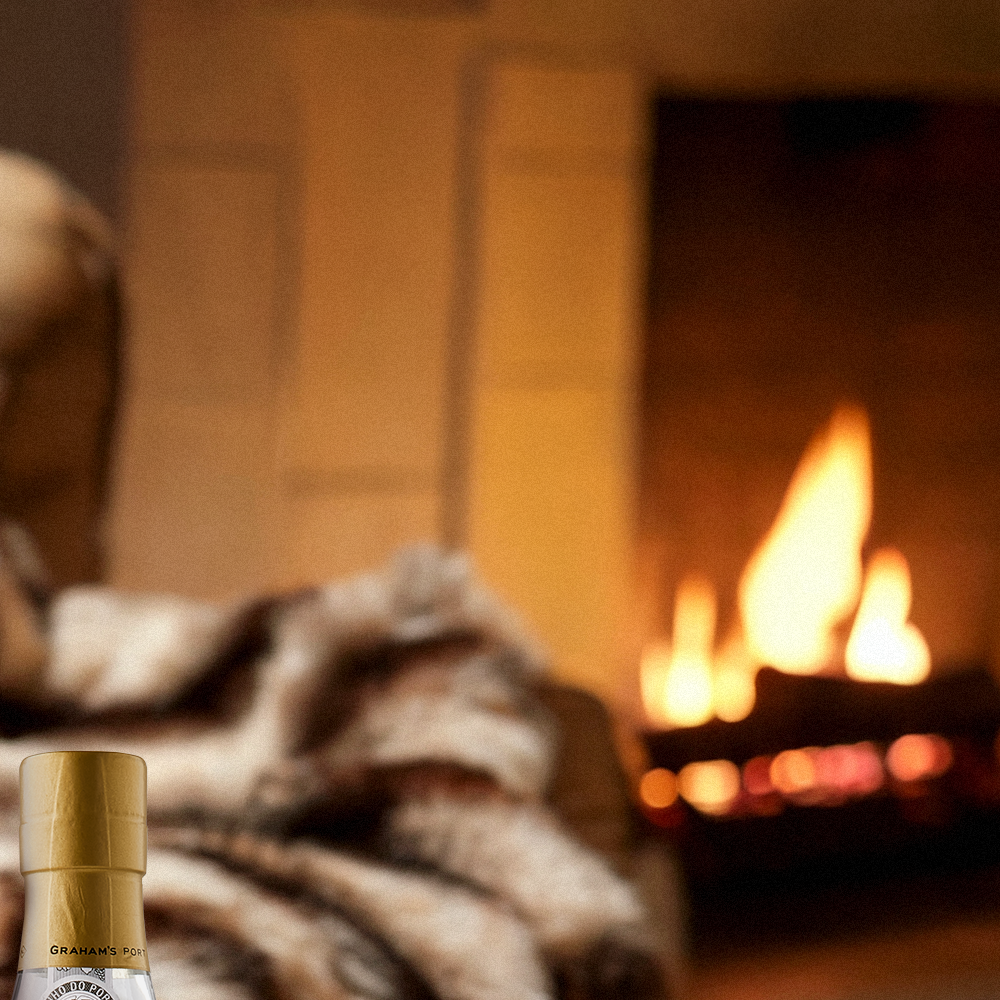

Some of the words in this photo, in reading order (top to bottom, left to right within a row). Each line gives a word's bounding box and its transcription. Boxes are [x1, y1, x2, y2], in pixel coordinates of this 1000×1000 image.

[50, 945, 117, 956] GRAHAM'S
[123, 947, 146, 957] PORT
[70, 981, 85, 992] DO
